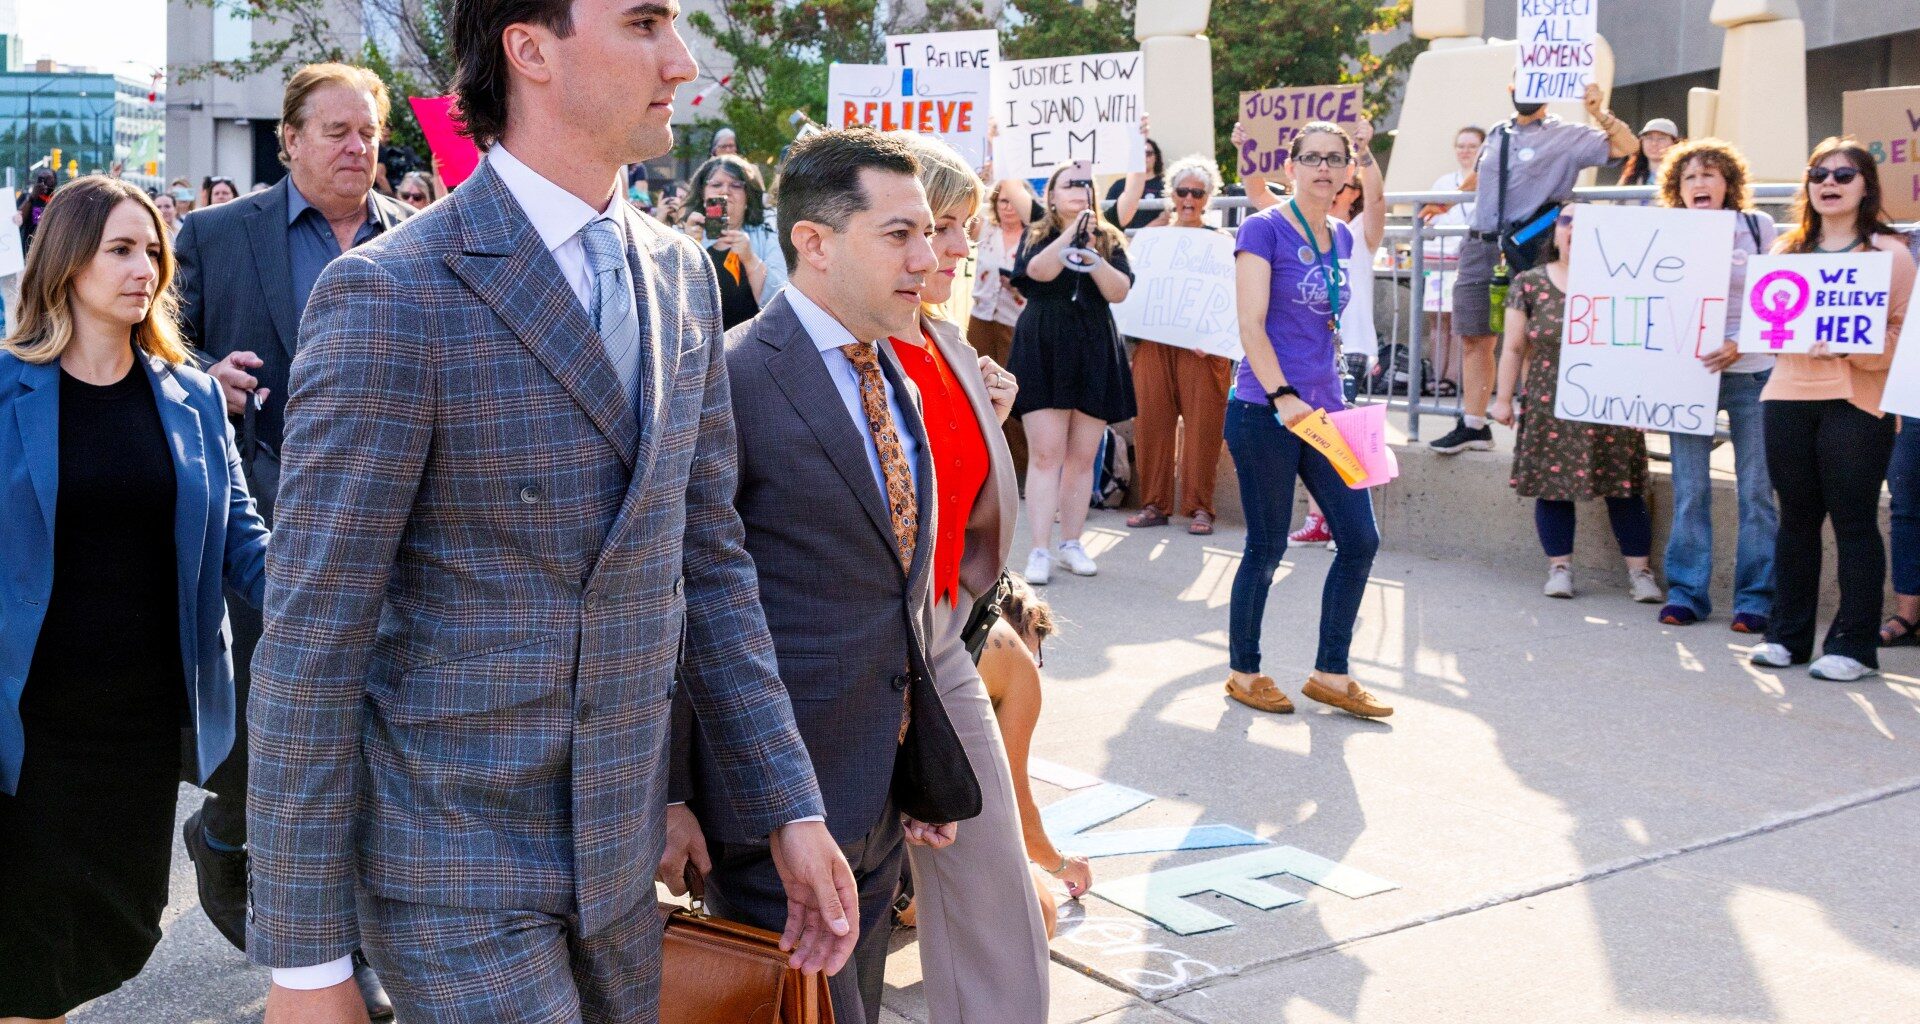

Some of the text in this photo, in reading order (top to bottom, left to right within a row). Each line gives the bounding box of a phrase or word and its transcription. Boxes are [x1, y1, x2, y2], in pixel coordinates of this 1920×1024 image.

[1521, 0, 1590, 17] RESPECT
[1533, 19, 1582, 42] ALL
[895, 42, 990, 69] I BELIEVE
[1009, 56, 1139, 90] JUSTICE NOW
[1526, 72, 1588, 99] TRUTHS
[843, 100, 973, 133] BELIEVE
[1006, 94, 1137, 128] I STAND WITH
[1245, 89, 1357, 123] JUSTICE
[1240, 138, 1290, 176] SUR
[1867, 138, 1920, 164] BEL
[1135, 235, 1235, 279] I Believ
[1594, 226, 1686, 284] We
[1819, 268, 1858, 285] WE
[1815, 290, 1888, 308] BELIEVE
[1568, 294, 1725, 360] BELIEVE
[1815, 315, 1873, 346] HER
[1561, 362, 1705, 431] Survivors
[1304, 427, 1331, 449] CHANTS
